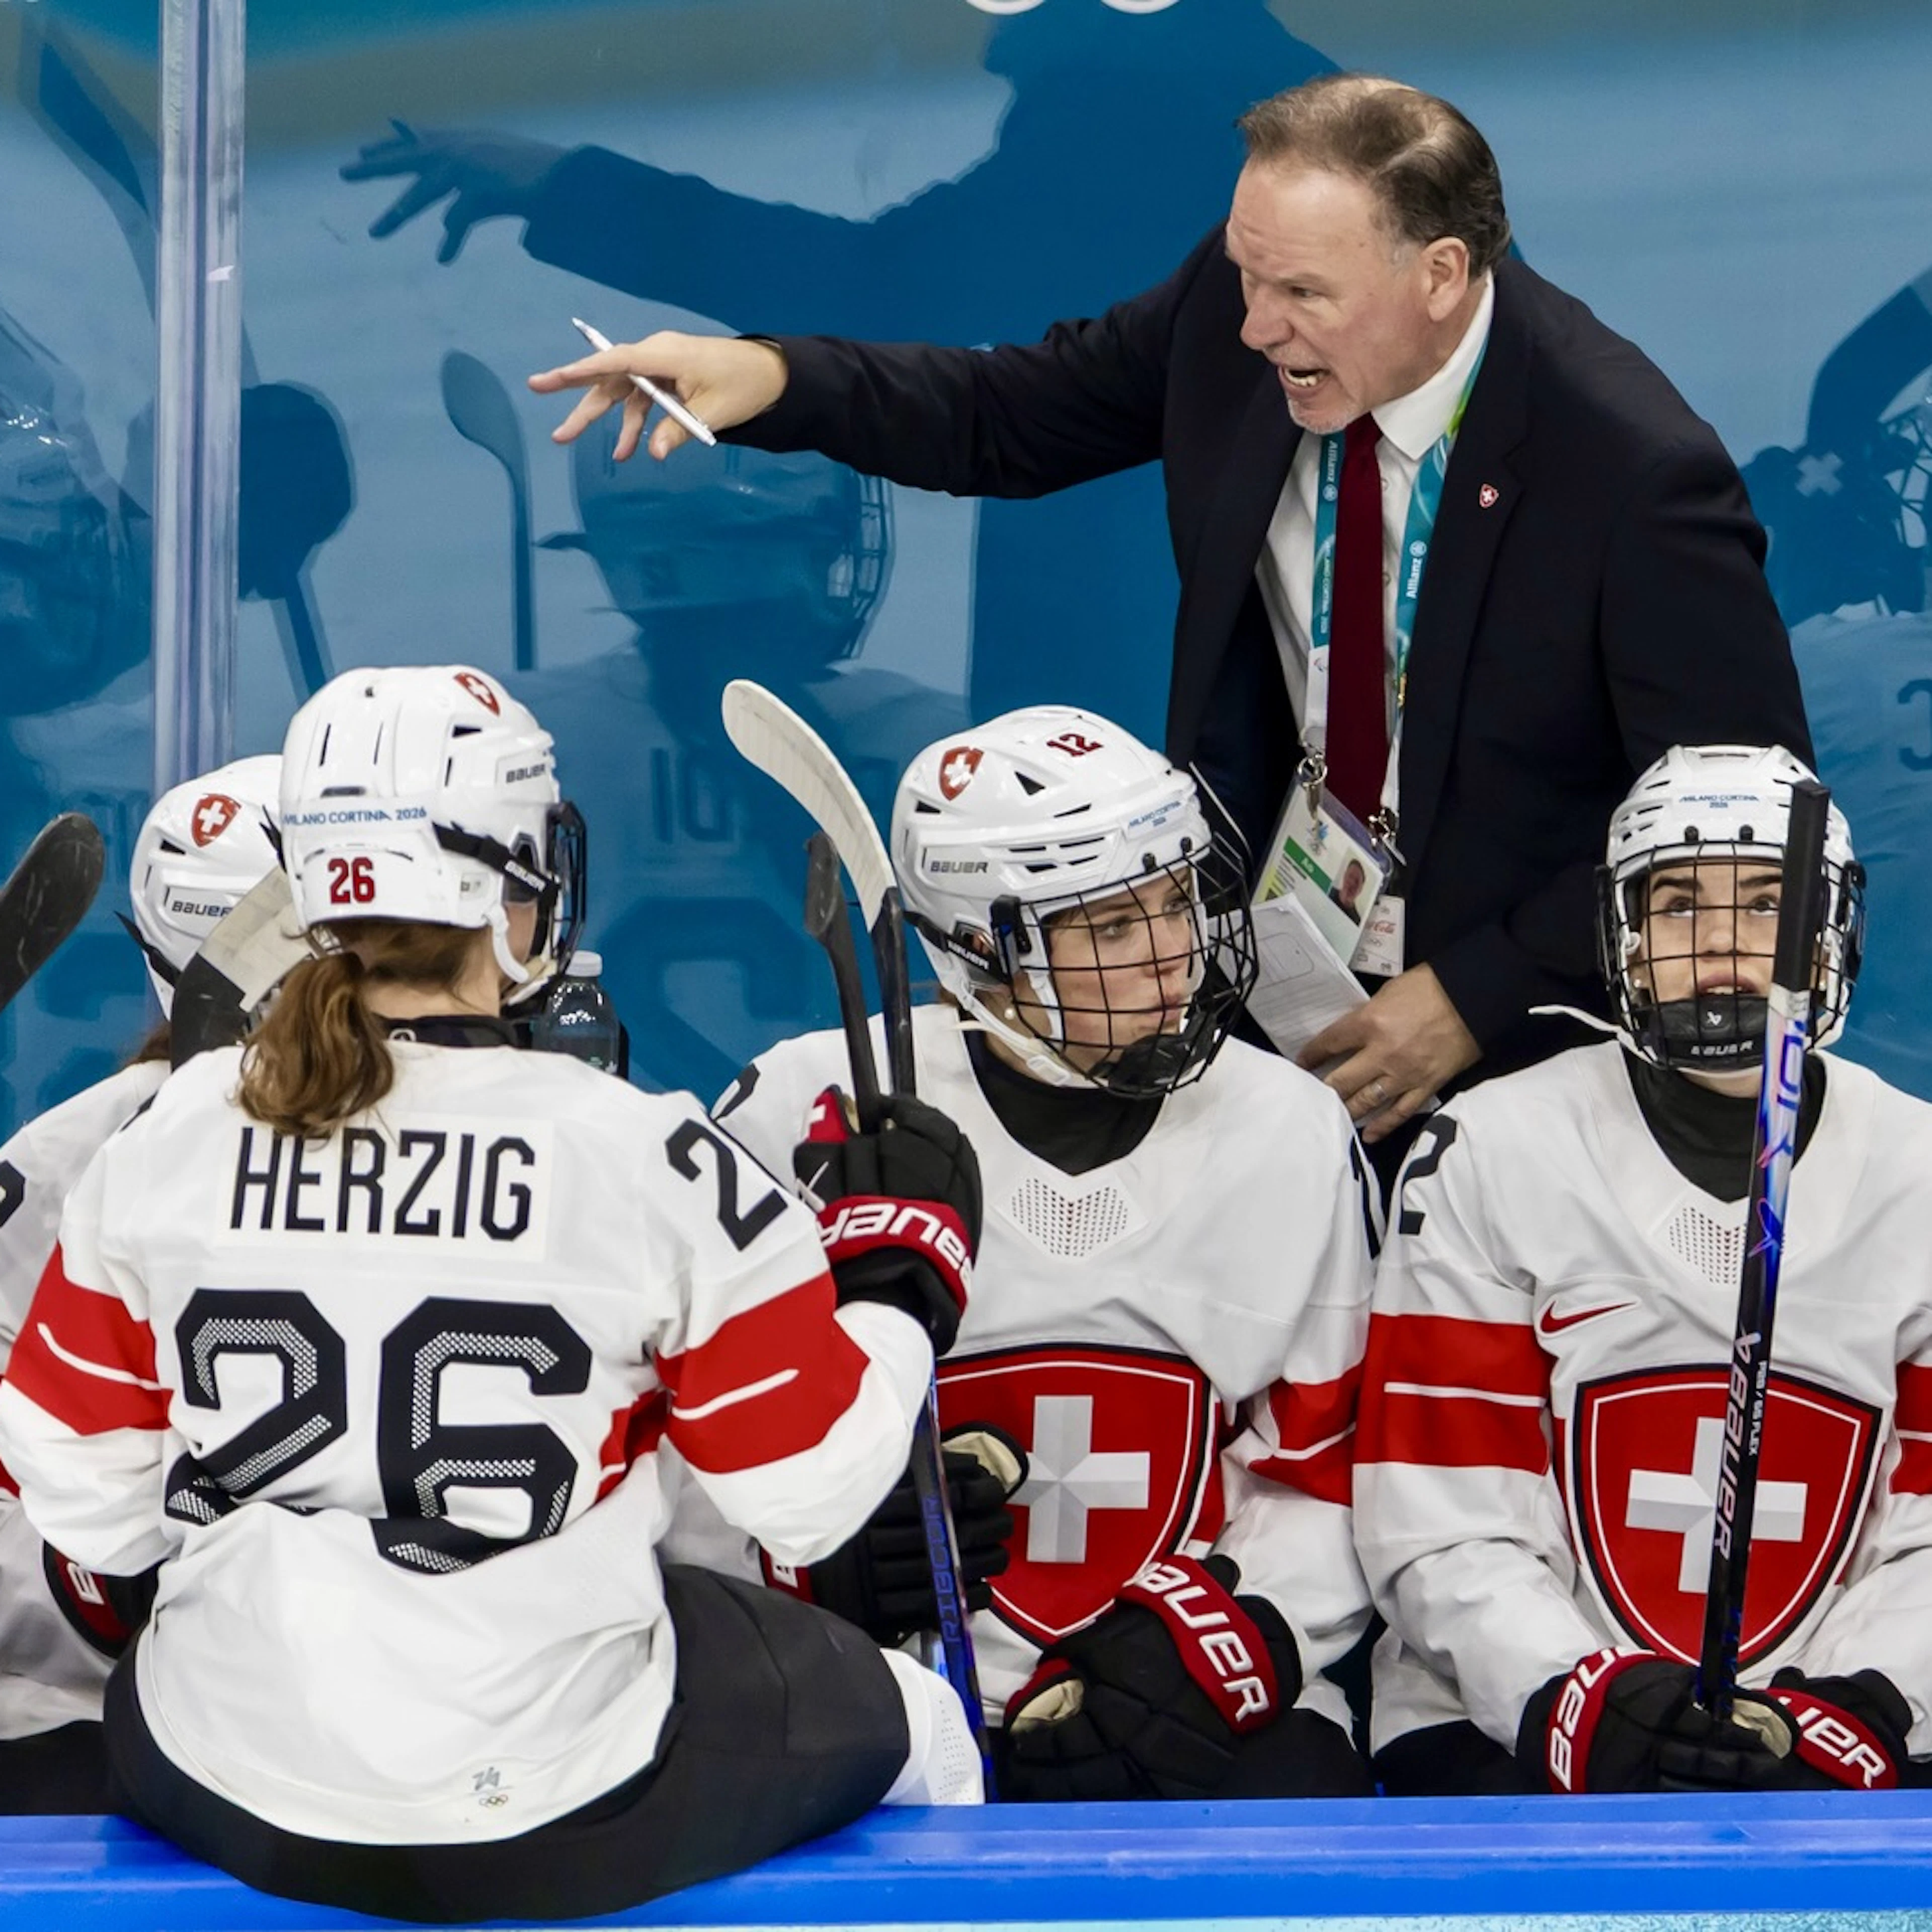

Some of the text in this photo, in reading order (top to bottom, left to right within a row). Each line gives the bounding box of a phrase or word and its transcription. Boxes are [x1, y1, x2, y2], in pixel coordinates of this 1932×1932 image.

[1406, 557, 1423, 599] Allianz
[1046, 733, 1103, 757] 12
[282, 807, 427, 825] MILANO CORTINA 2026
[328, 856, 376, 904] 26
[930, 861, 989, 873] BAUER
[230, 1126, 535, 1241] HERZIG
[166, 1288, 593, 1576] 26
[921, 1494, 960, 1642] RIBCOR
